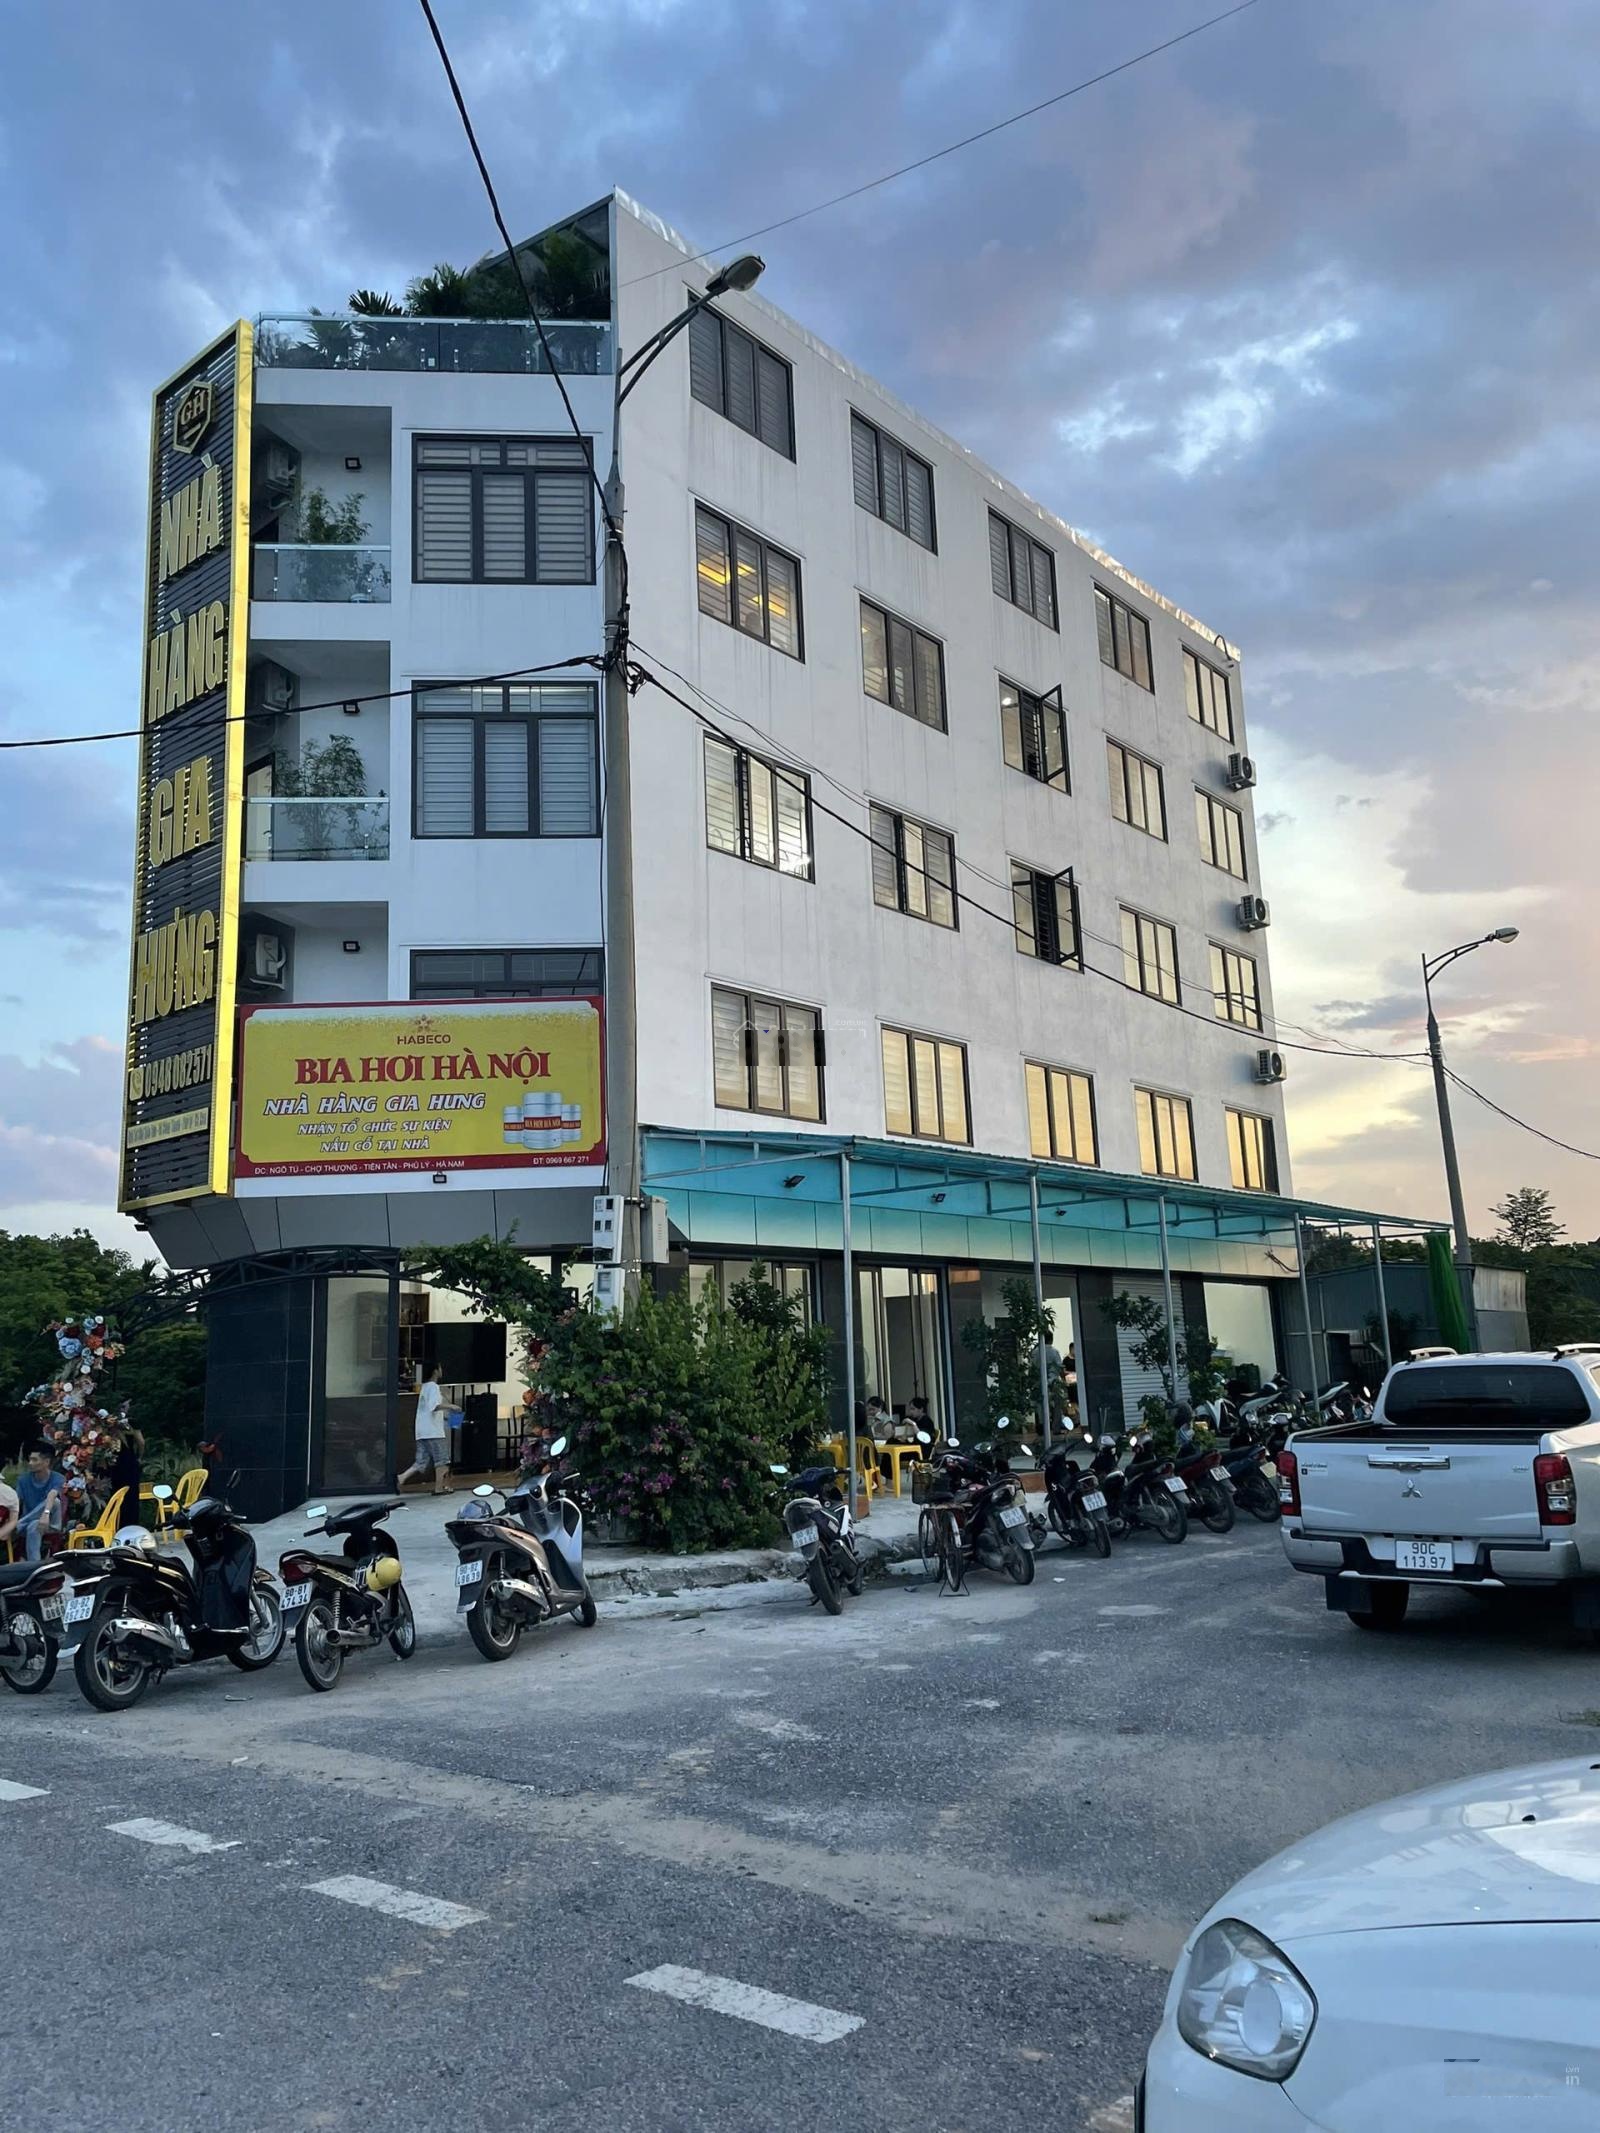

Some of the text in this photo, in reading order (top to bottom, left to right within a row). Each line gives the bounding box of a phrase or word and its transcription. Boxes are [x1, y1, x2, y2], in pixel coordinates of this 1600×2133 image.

[181, 389, 206, 425] GH
[158, 453, 223, 583] NHÀ
[148, 600, 225, 724] HÀNG
[150, 755, 212, 868] GIA
[135, 906, 216, 1025] HƯNG
[397, 1034, 451, 1045] HABECO
[295, 1046, 551, 1085] BIA HƠI HÀ NỘI
[263, 1092, 309, 1115] NHÀ
[317, 1091, 376, 1114] HÀNG
[385, 1094, 419, 1112] GIA
[577, 1155, 589, 1163] 271
[1403, 1555, 1446, 1569] 113.97
[1411, 1542, 1436, 1554] 90C
